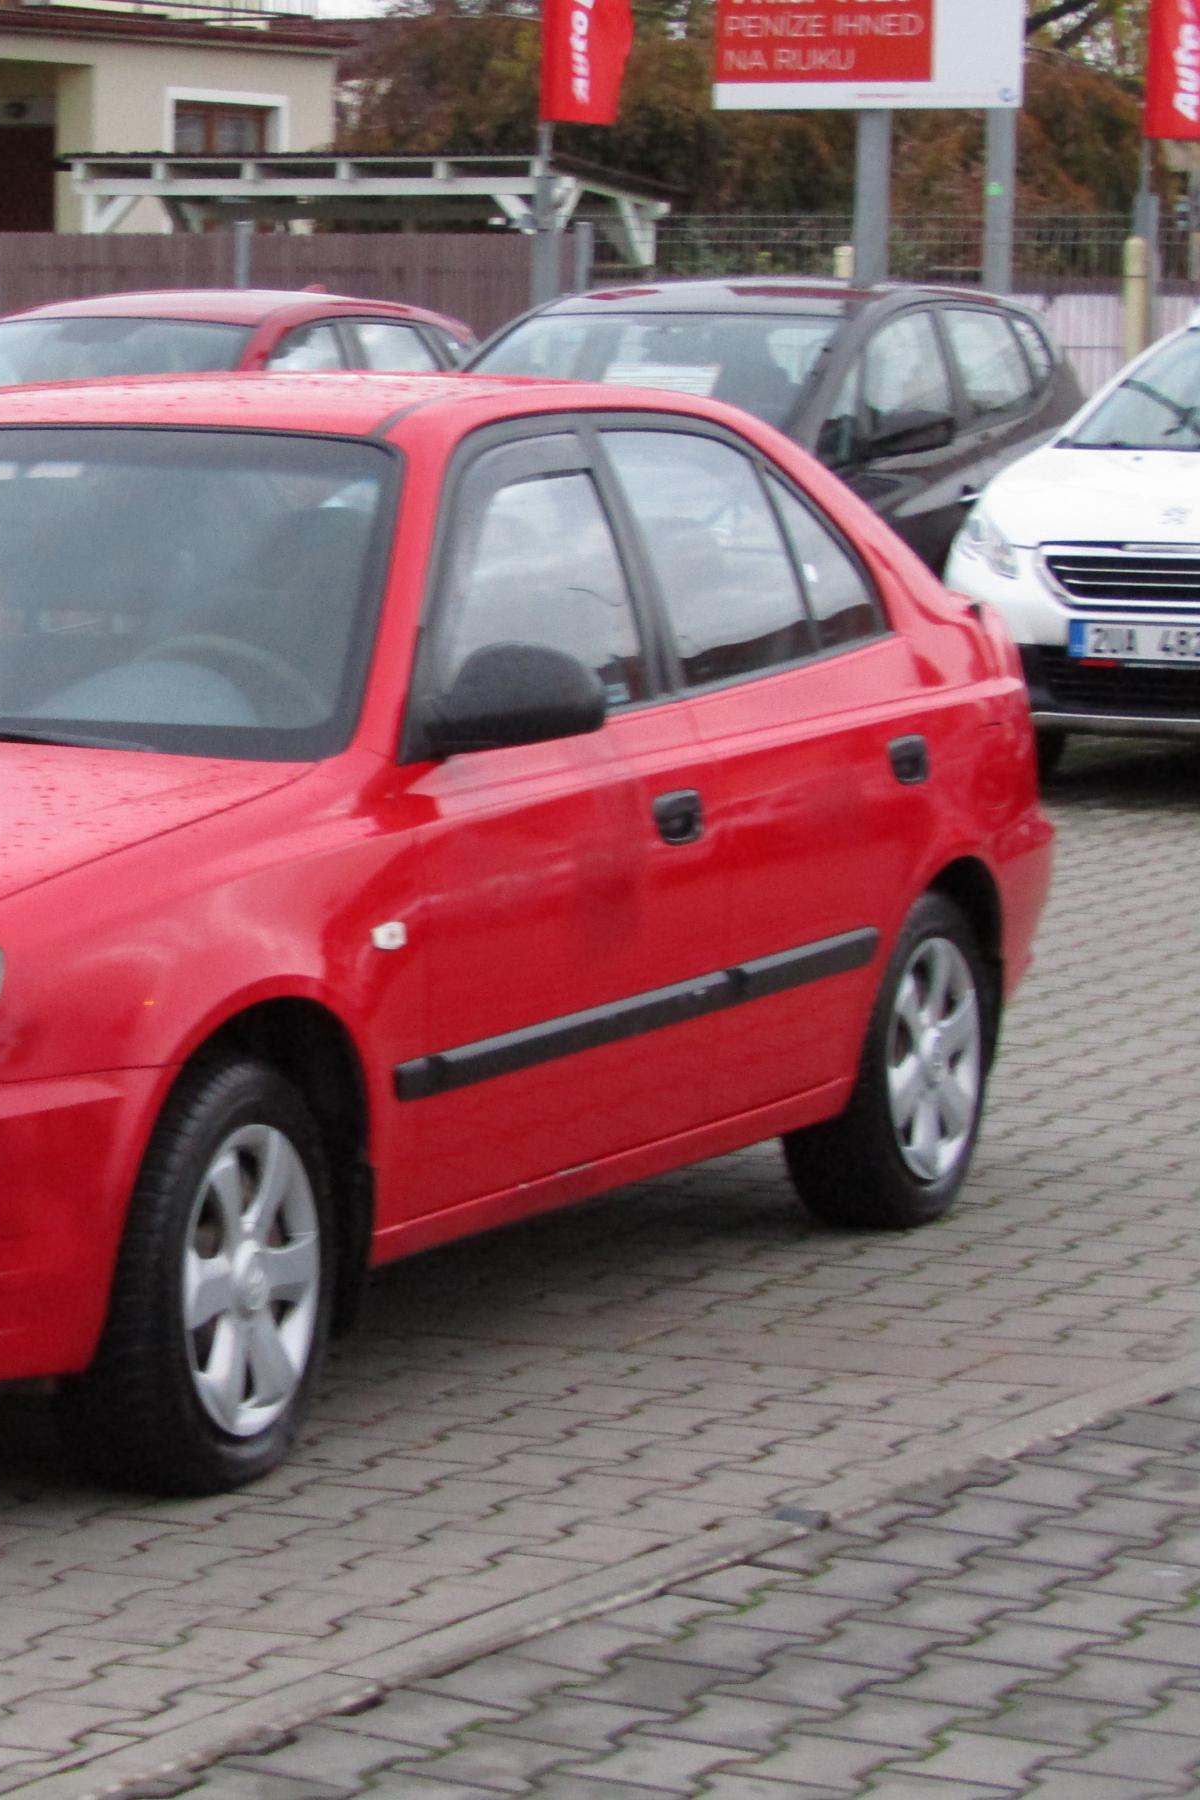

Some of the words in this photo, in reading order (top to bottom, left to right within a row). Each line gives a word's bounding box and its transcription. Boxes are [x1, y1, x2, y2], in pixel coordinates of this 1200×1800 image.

[832, 13, 924, 36] IHNED
[569, 10, 591, 105] Auto
[724, 50, 768, 71] NA
[773, 48, 856, 71] RUKU
[1172, 22, 1199, 122] Auto
